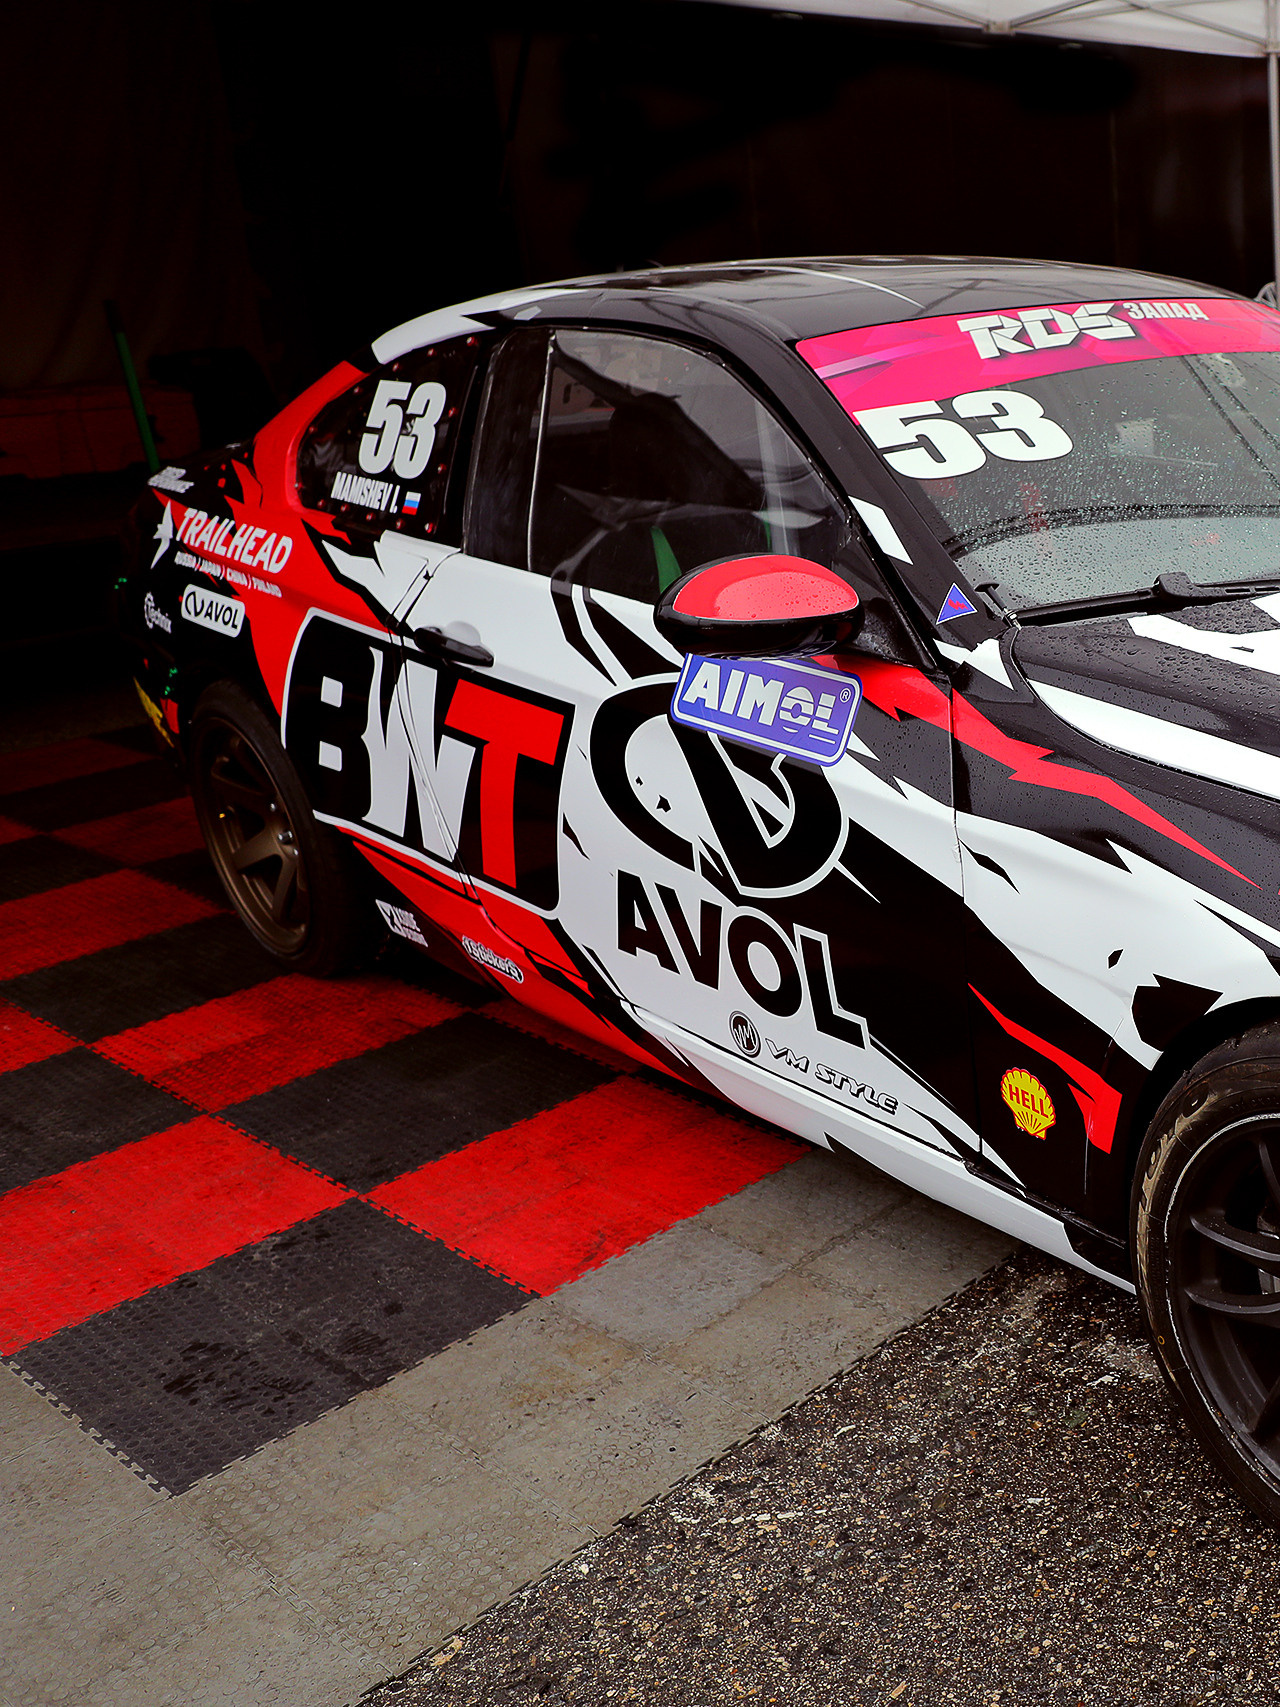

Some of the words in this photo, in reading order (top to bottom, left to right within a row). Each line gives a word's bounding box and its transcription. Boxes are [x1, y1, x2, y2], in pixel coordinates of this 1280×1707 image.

[957, 303, 1136, 360] RDS
[1122, 302, 1209, 321] ЗАПАД
[358, 379, 447, 479] 53
[852, 390, 1074, 480] 53
[176, 507, 293, 574] TRAILHEAD
[204, 599, 240, 630] AVOL
[682, 660, 841, 735] AIMOL
[617, 868, 868, 1051] AVOL
[765, 1037, 810, 1073] VM
[815, 1063, 899, 1115] STYLE
[1008, 1081, 1051, 1119] HELL
